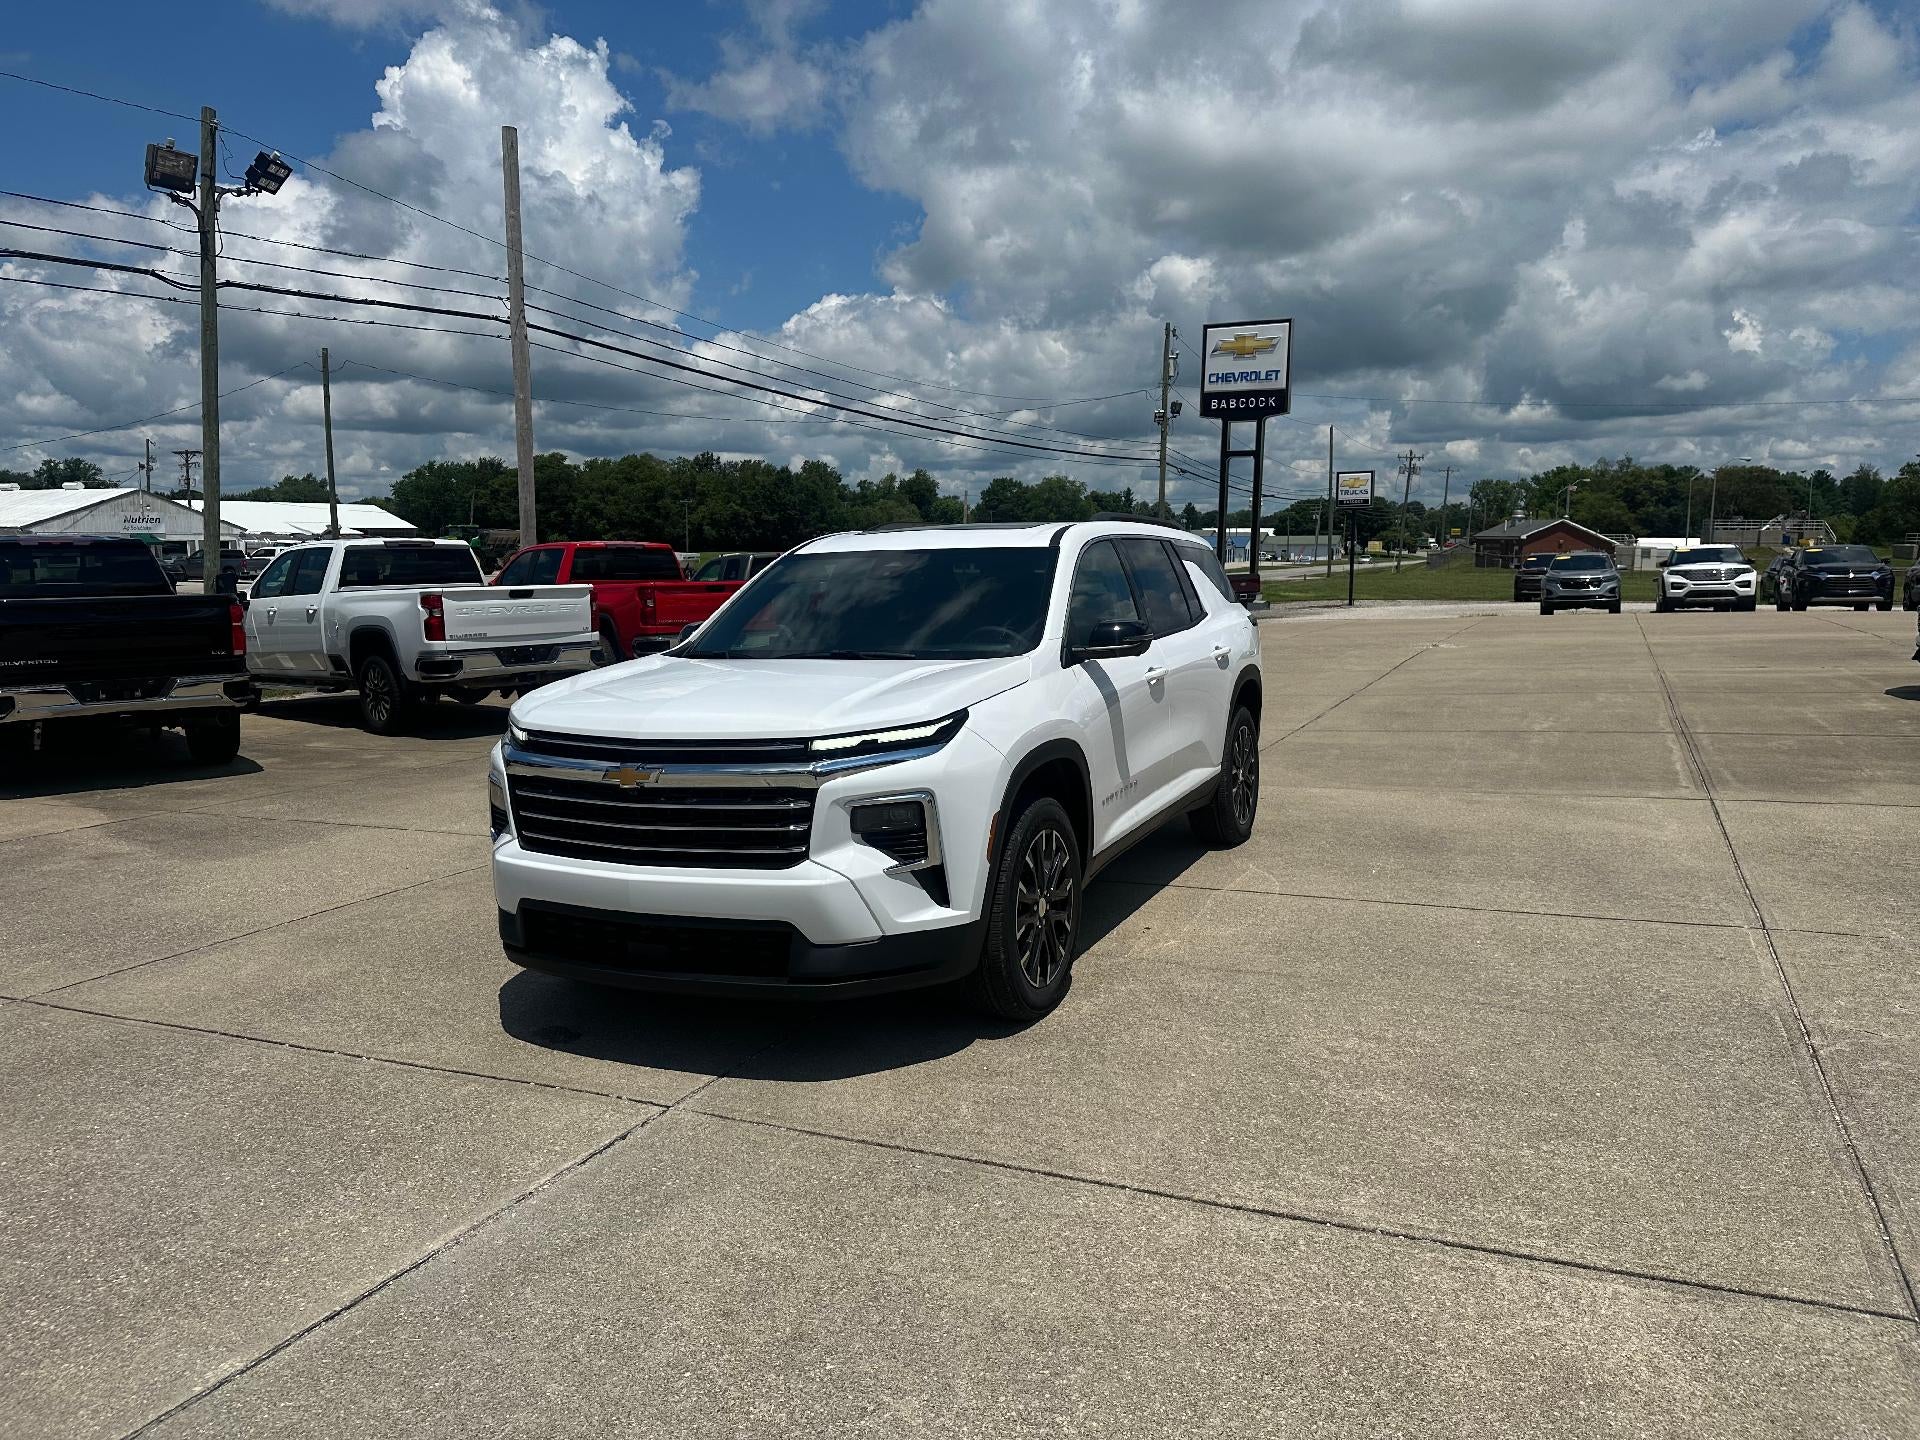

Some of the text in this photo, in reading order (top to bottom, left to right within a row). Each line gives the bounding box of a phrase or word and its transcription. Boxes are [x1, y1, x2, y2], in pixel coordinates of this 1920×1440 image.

[1208, 370, 1281, 384] CHEVROLET
[1210, 397, 1276, 409] BABCOCK
[123, 514, 161, 524] Nutrien
[455, 603, 583, 617] CHEVROLET
